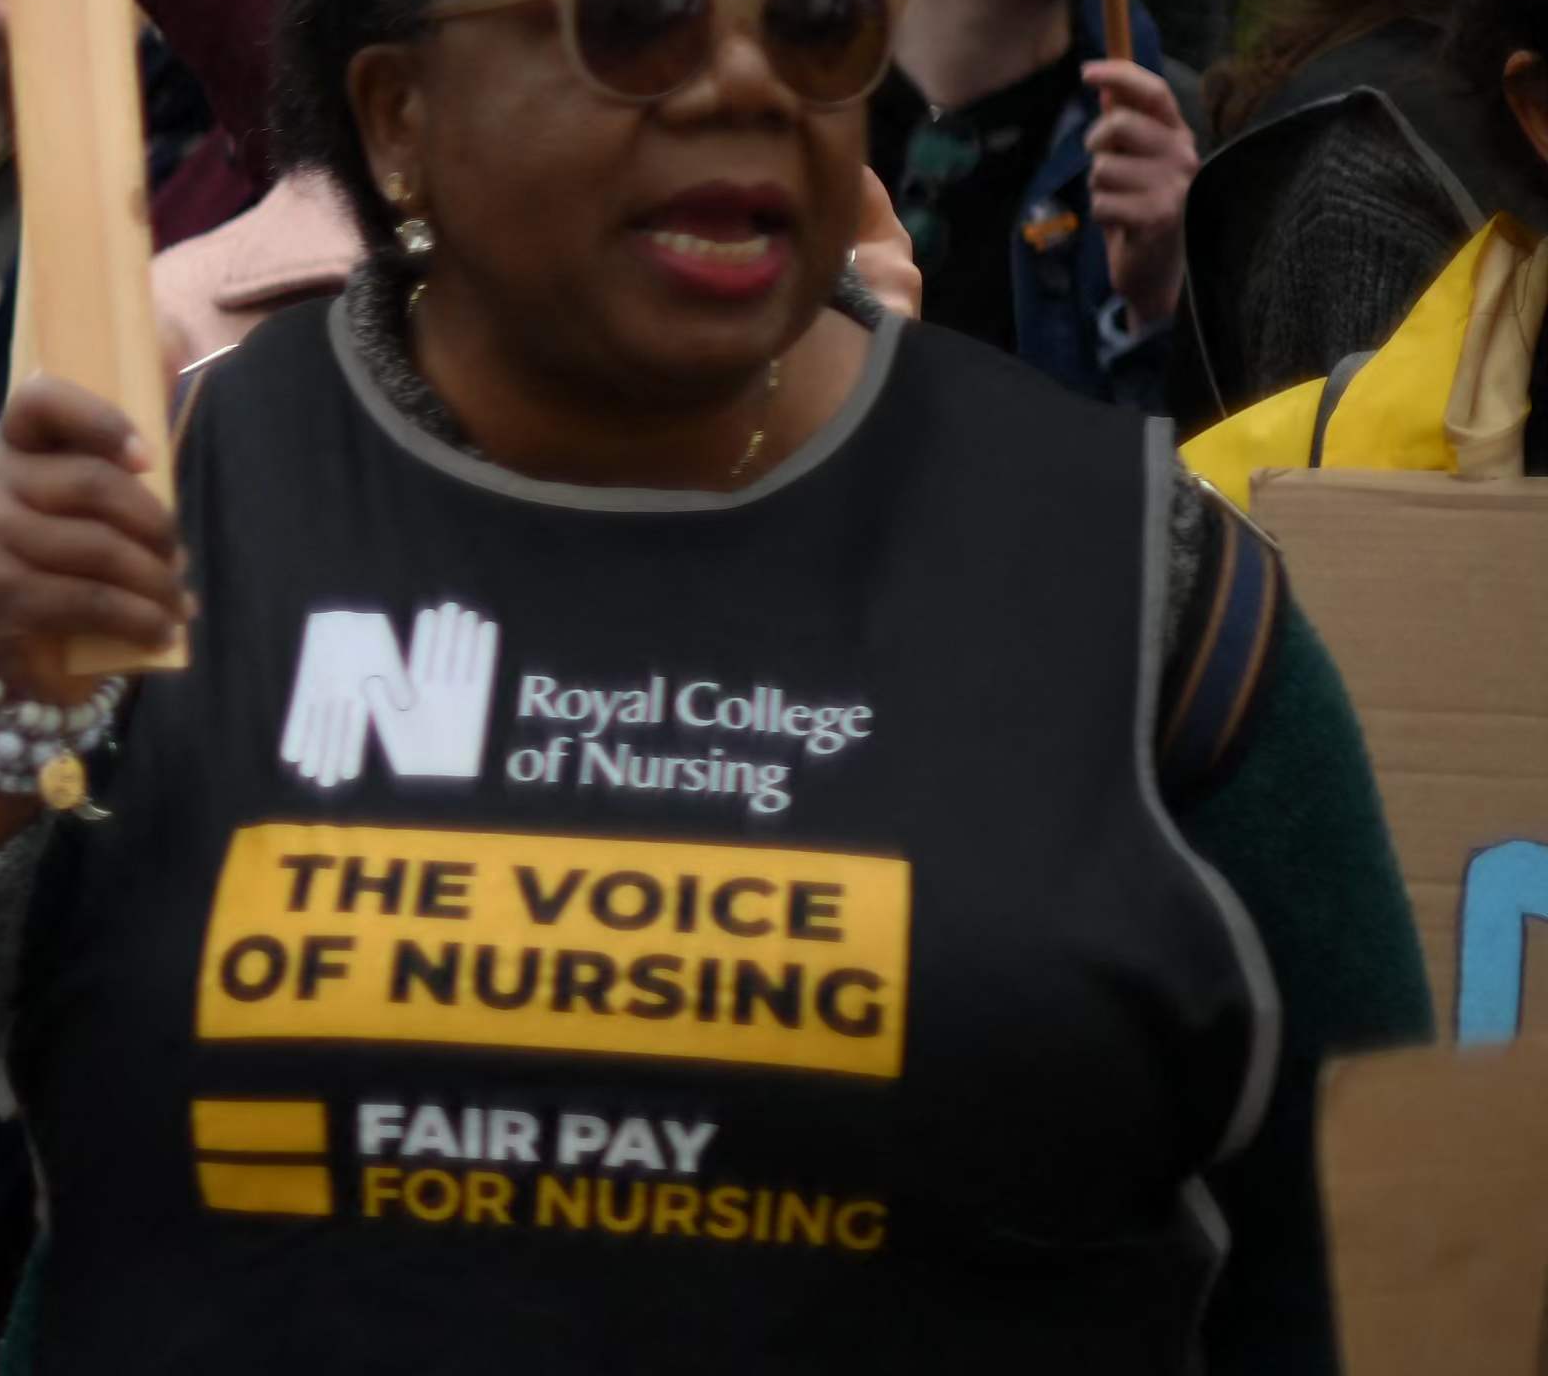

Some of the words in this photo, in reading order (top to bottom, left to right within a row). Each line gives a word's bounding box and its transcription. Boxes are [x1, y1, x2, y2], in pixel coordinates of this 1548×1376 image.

[518, 673, 665, 732] Royal
[675, 680, 874, 755] College
[506, 736, 569, 784] of
[578, 741, 792, 814] Nursing
[279, 853, 477, 921] THE
[514, 865, 847, 944] VOICE
[218, 935, 359, 1005] OF
[389, 941, 886, 1040] NURSING
[357, 1102, 539, 1163] FAIR
[557, 1112, 719, 1174] PAY
[363, 1167, 516, 1224] FOR
[534, 1174, 888, 1251] NURSING
